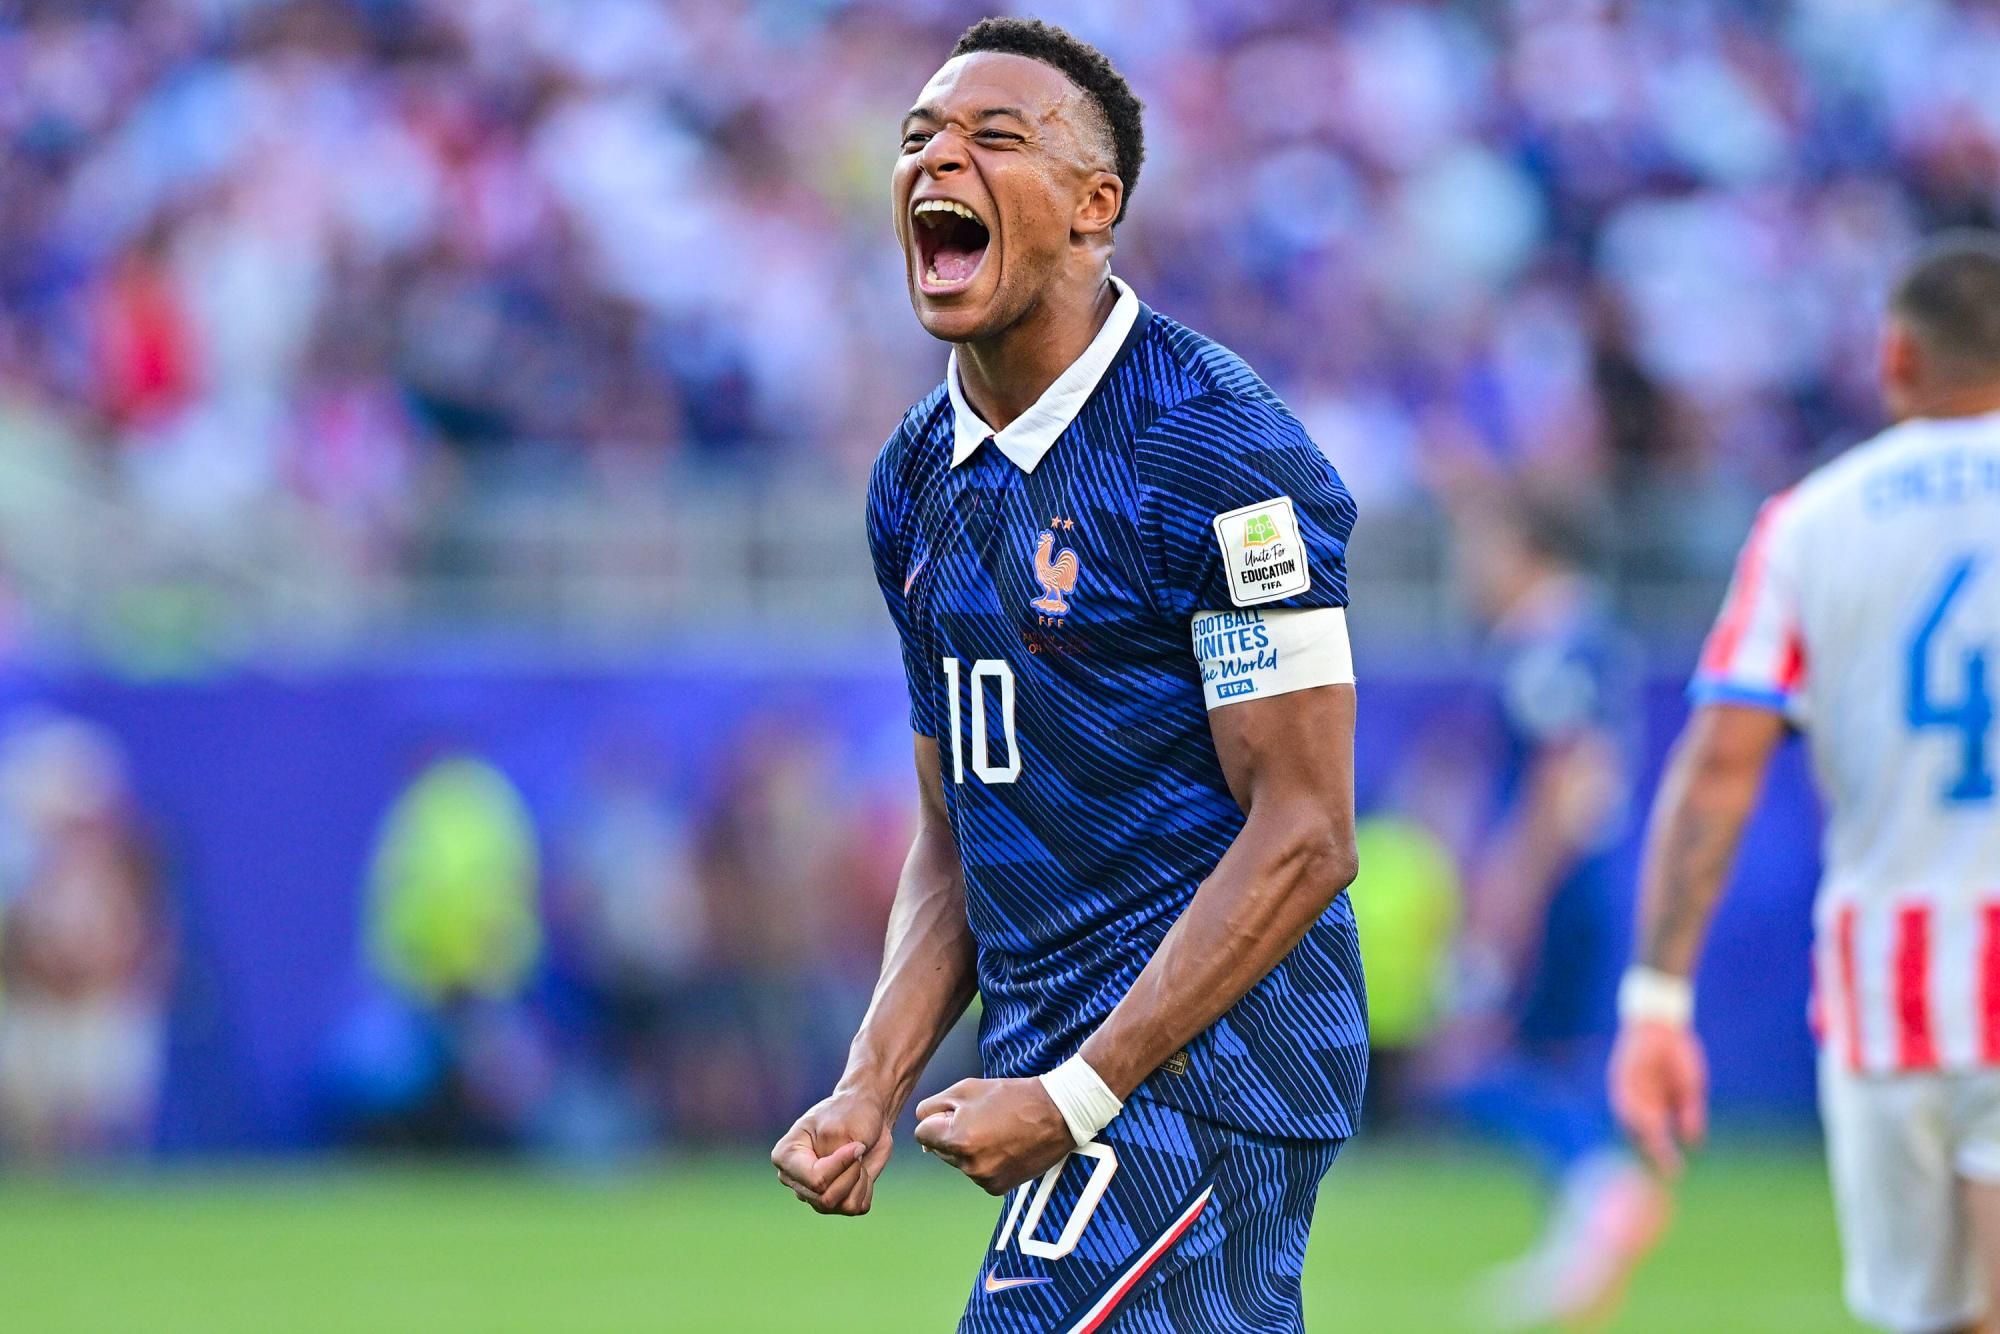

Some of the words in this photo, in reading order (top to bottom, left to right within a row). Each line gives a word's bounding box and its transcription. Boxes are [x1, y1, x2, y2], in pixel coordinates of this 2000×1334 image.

[1244, 548, 1271, 567] Unite
[1271, 543, 1286, 560] For
[1241, 559, 1295, 584] EDUCATION
[1261, 580, 1282, 591] FIFA
[1193, 610, 1264, 638] FOOTBALL
[1195, 625, 1269, 662] UNITES
[1219, 648, 1277, 678] World
[1219, 681, 1252, 696] FIFA
[1908, 556, 1993, 801] 4
[942, 657, 1020, 784] 10
[995, 1141, 1118, 1260] 10
